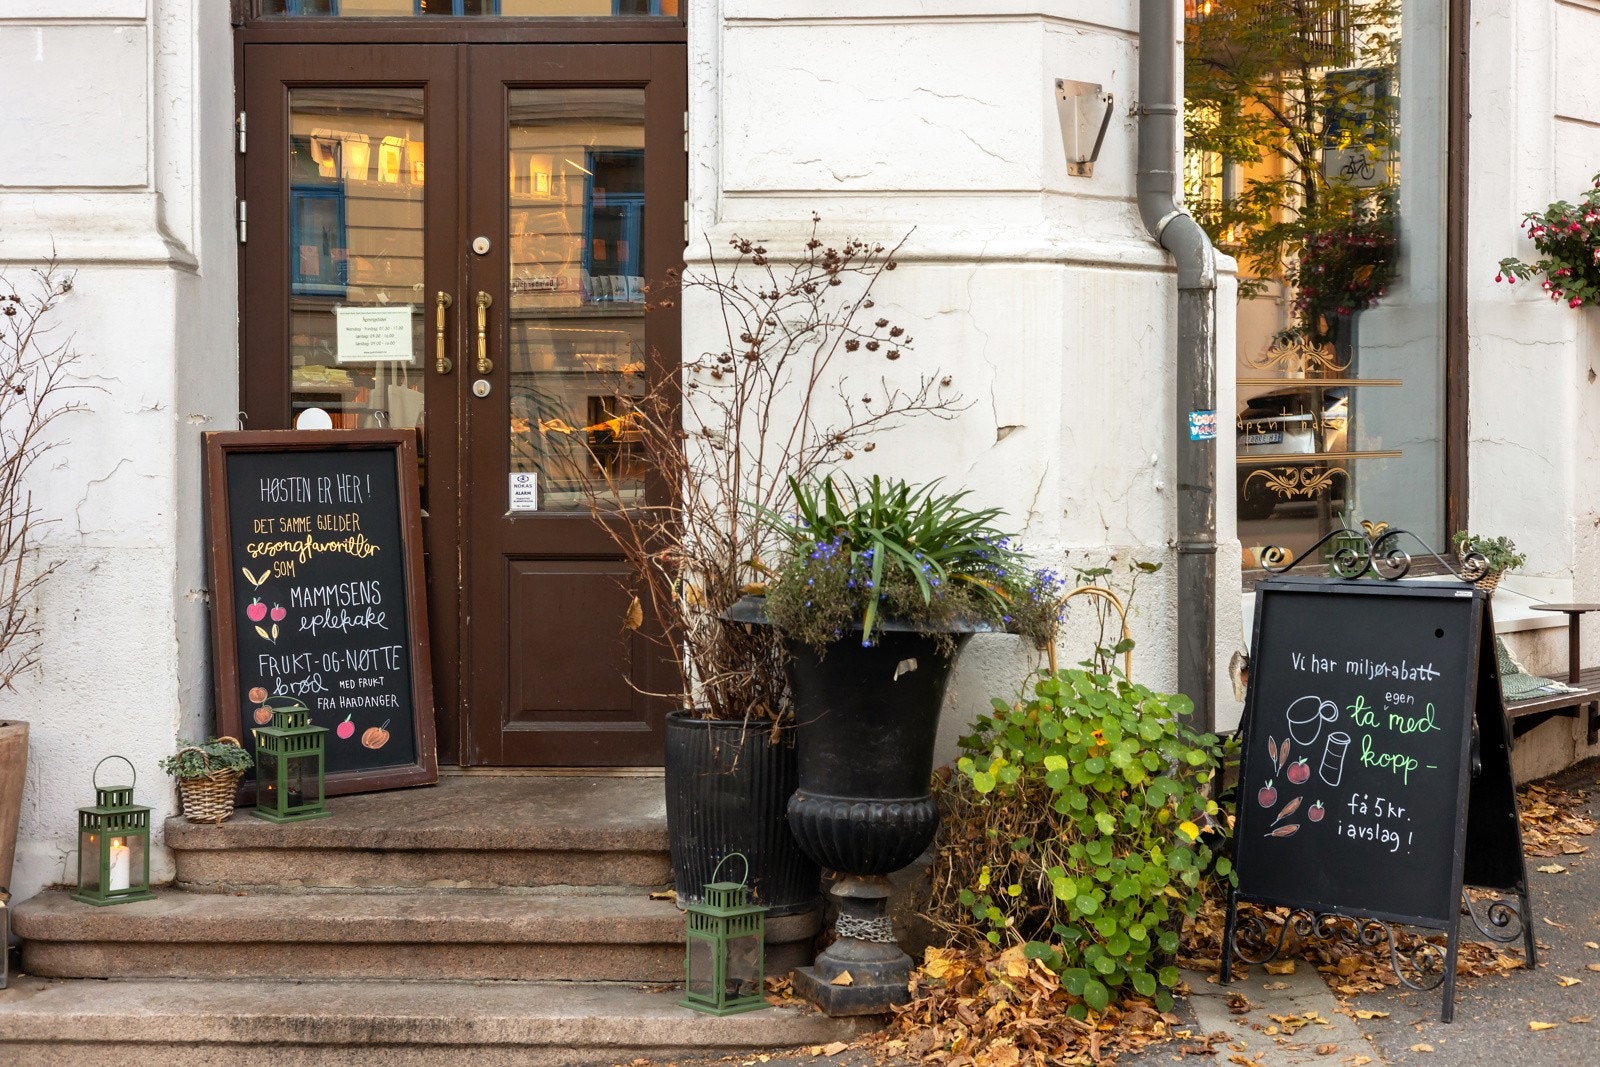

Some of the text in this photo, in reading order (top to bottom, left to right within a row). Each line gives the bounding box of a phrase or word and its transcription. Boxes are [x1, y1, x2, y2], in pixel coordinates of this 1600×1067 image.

[260, 477, 311, 503] HØSTEN
[318, 476, 333, 504] ER
[336, 473, 363, 504] HER
[254, 513, 360, 534] DET SAMME GJELDER
[246, 534, 380, 564] sesongfavoritter
[273, 560, 296, 578] SOM
[290, 580, 382, 608] MAMMSENS
[298, 606, 388, 636] eplekake
[1292, 652, 1441, 681] Vi har miljørabatt
[273, 672, 328, 696] brød
[340, 676, 384, 690] MED FRUKT
[318, 694, 400, 710] FRA HARDANGER
[1385, 692, 1414, 705] egen
[1346, 696, 1441, 733] ta med
[1348, 794, 1367, 815] få
